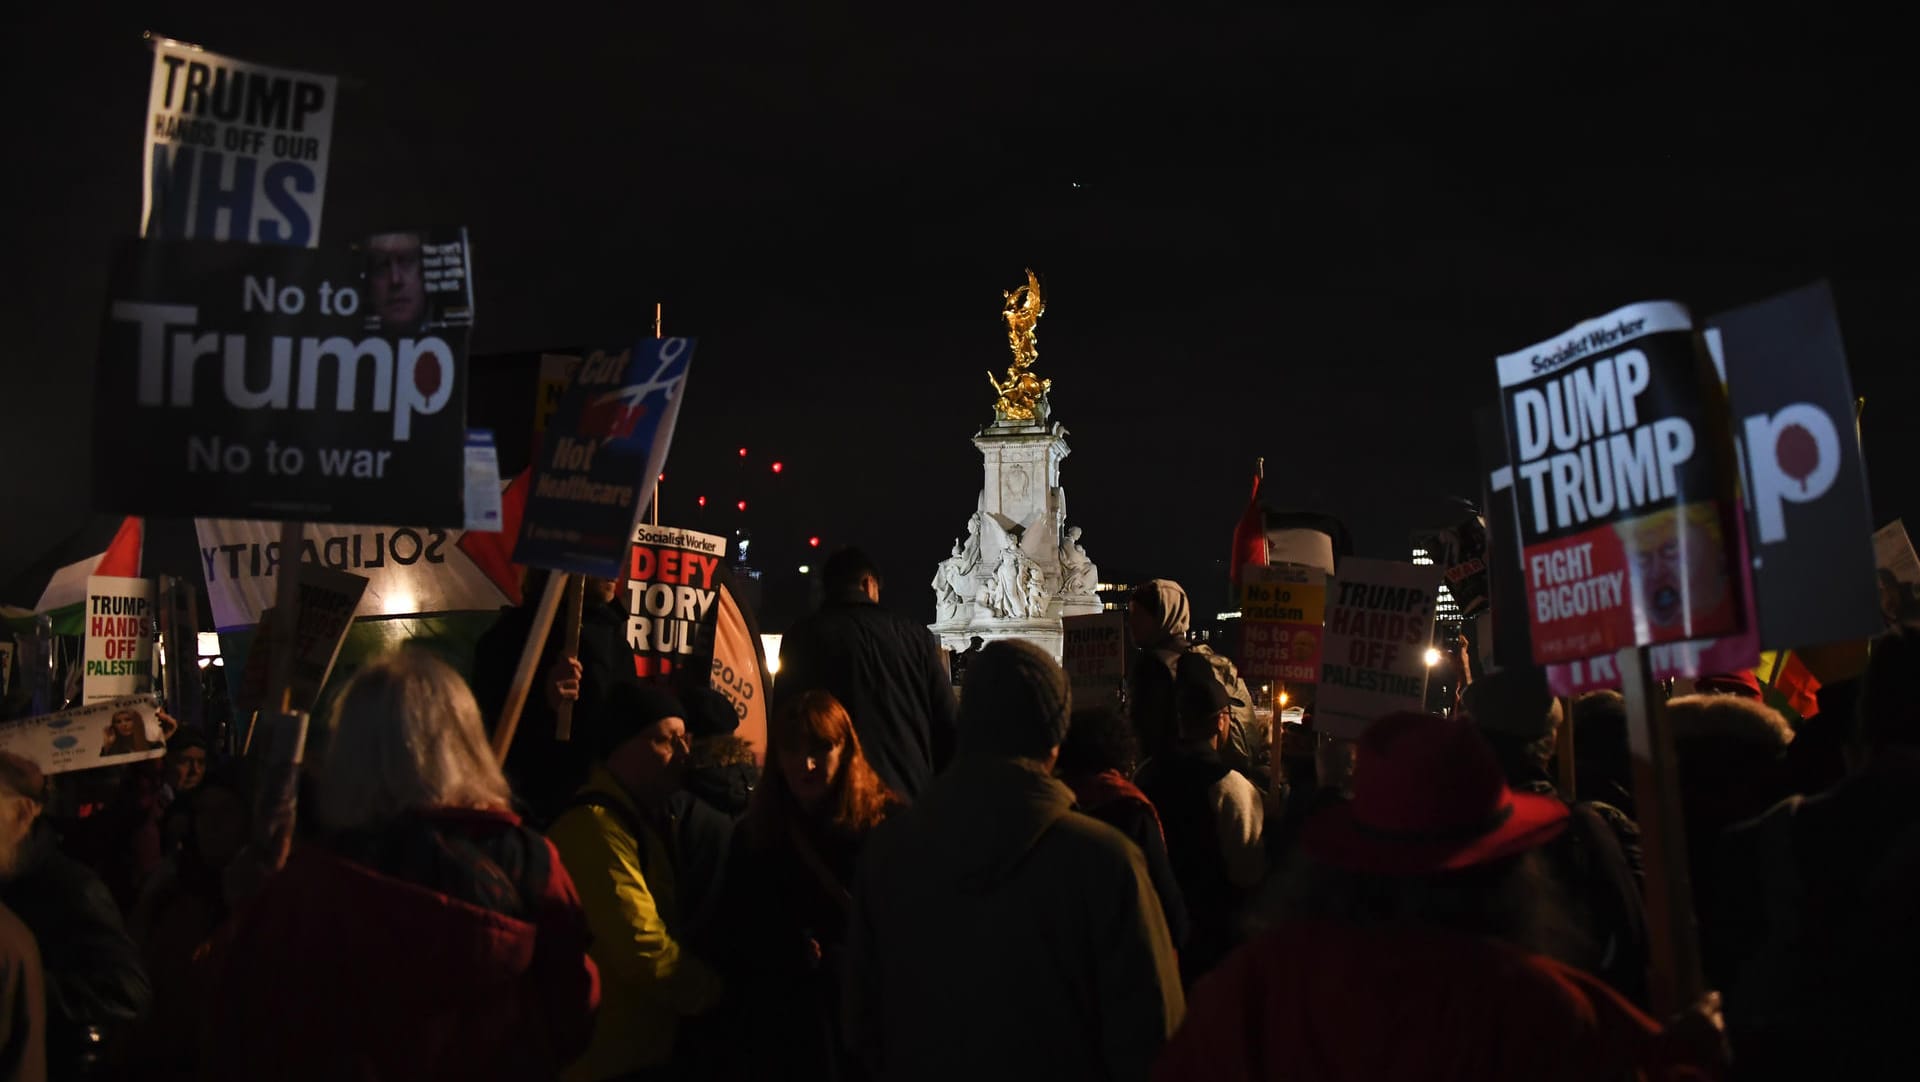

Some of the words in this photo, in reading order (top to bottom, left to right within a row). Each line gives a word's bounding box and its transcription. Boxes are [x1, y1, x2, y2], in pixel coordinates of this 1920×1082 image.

[163, 55, 325, 132] TRUMP
[154, 114, 217, 147] HANDS
[223, 125, 266, 154] OFF
[273, 134, 319, 161] OUR
[152, 142, 316, 249] NHS
[242, 274, 305, 316] No
[318, 280, 359, 316] to
[1532, 336, 1588, 374] Socialist
[1589, 316, 1646, 350] Worker
[112, 301, 455, 441] Trump
[577, 348, 633, 385] Cut
[1513, 348, 1651, 462] DUMP
[187, 435, 250, 474] No
[265, 440, 305, 476] to
[318, 449, 392, 478] war
[551, 436, 597, 472] Not
[1519, 416, 1697, 535] TRUMP
[638, 528, 685, 546] Socialist
[686, 533, 716, 552] Worker
[630, 545, 719, 590] DEFY
[1531, 542, 1594, 588] FIGHT
[627, 580, 717, 622] TORY
[1247, 585, 1268, 602] No
[1274, 586, 1291, 603] to
[1247, 603, 1304, 621] racism
[1337, 581, 1431, 614] TRUMP:
[1534, 570, 1625, 624] BIGOTRY
[91, 617, 149, 638] HANDS
[626, 614, 698, 656] RUL
[1246, 625, 1268, 641] No
[1271, 626, 1290, 643] to
[1331, 610, 1425, 646] HANDS
[105, 639, 137, 660] OFF
[1244, 642, 1290, 660] Boris
[1348, 640, 1399, 670] OFF
[1245, 660, 1315, 680] Johnson
[1321, 663, 1422, 698] PALESTINE
